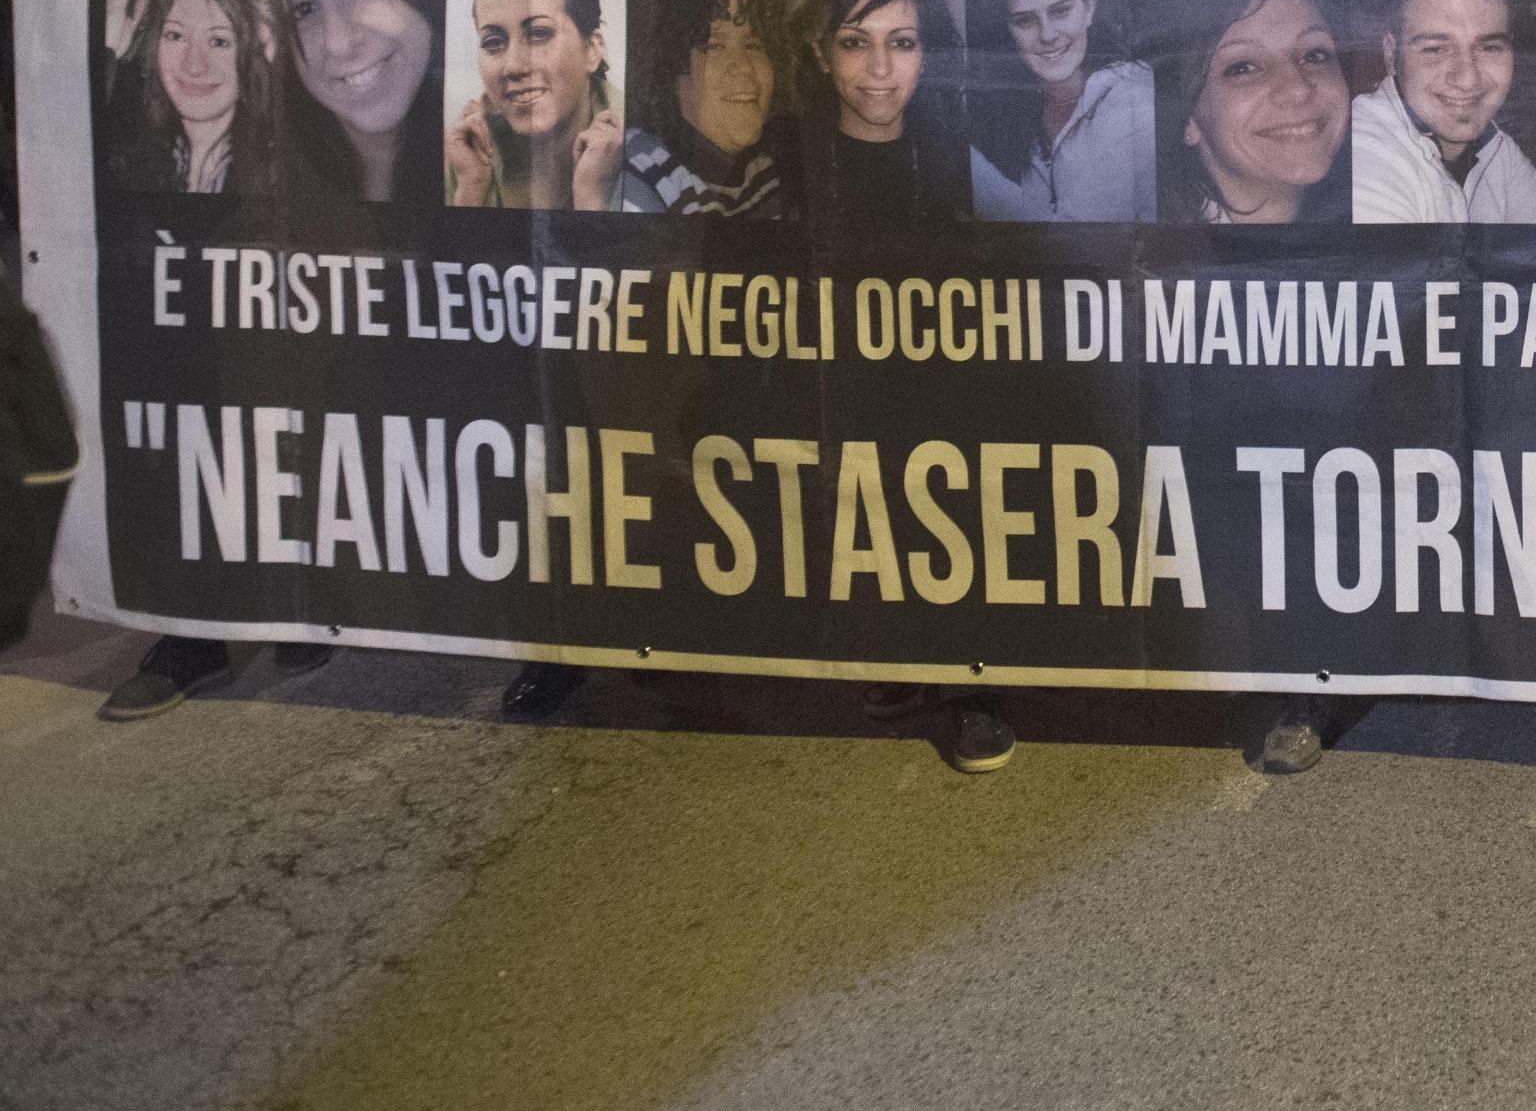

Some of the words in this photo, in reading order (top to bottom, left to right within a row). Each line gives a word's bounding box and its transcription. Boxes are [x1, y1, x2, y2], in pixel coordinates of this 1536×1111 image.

[154, 230, 186, 327] È
[202, 248, 386, 336] TRISTE
[403, 259, 648, 354] LEGGERE
[667, 271, 834, 360] NEGLI
[856, 276, 1043, 361] OCCHI
[1065, 279, 1122, 364] DI
[1145, 279, 1404, 368] MAMMA
[1425, 282, 1460, 366] E
[123, 400, 662, 589] "NEANCHE
[693, 435, 1206, 610] STASERA
